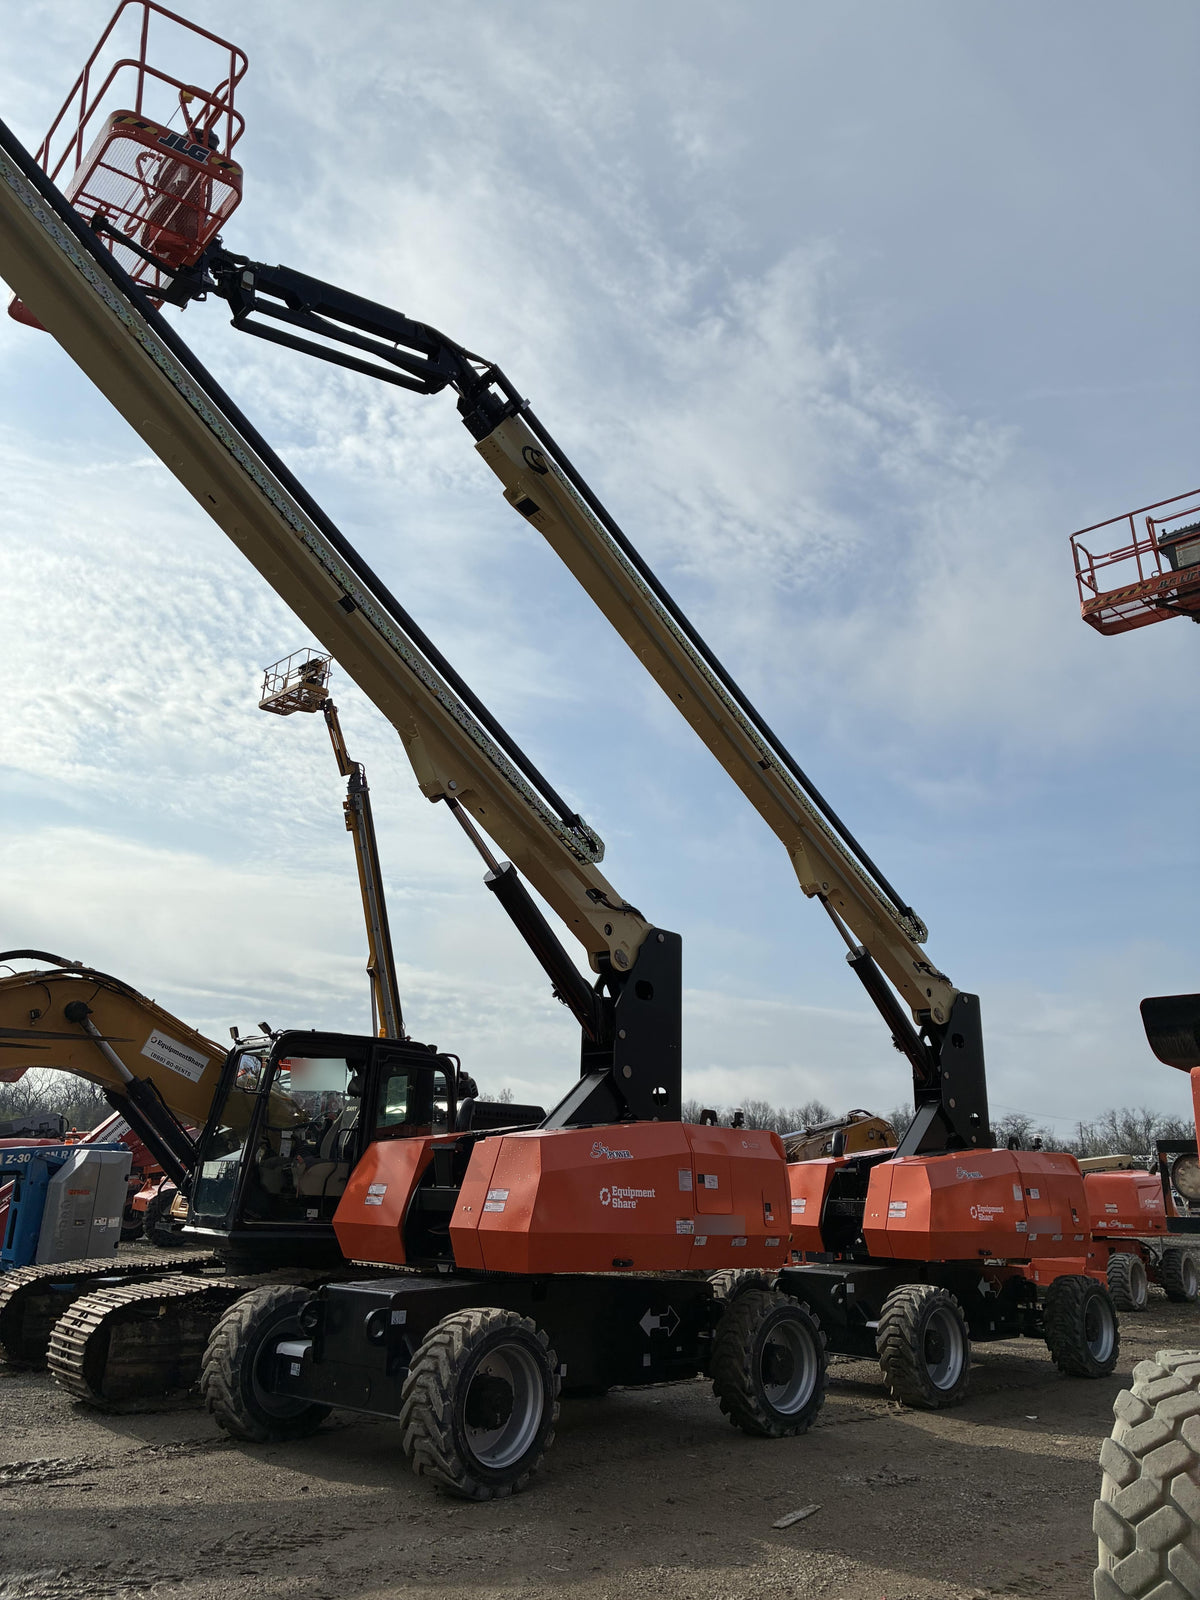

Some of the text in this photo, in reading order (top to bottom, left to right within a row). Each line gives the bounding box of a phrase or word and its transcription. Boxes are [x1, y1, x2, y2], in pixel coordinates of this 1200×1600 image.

[157, 132, 211, 163] JLG
[5, 1153, 31, 1165] Z-30
[611, 1185, 656, 1199] Equipment
[612, 1198, 637, 1209] Share
